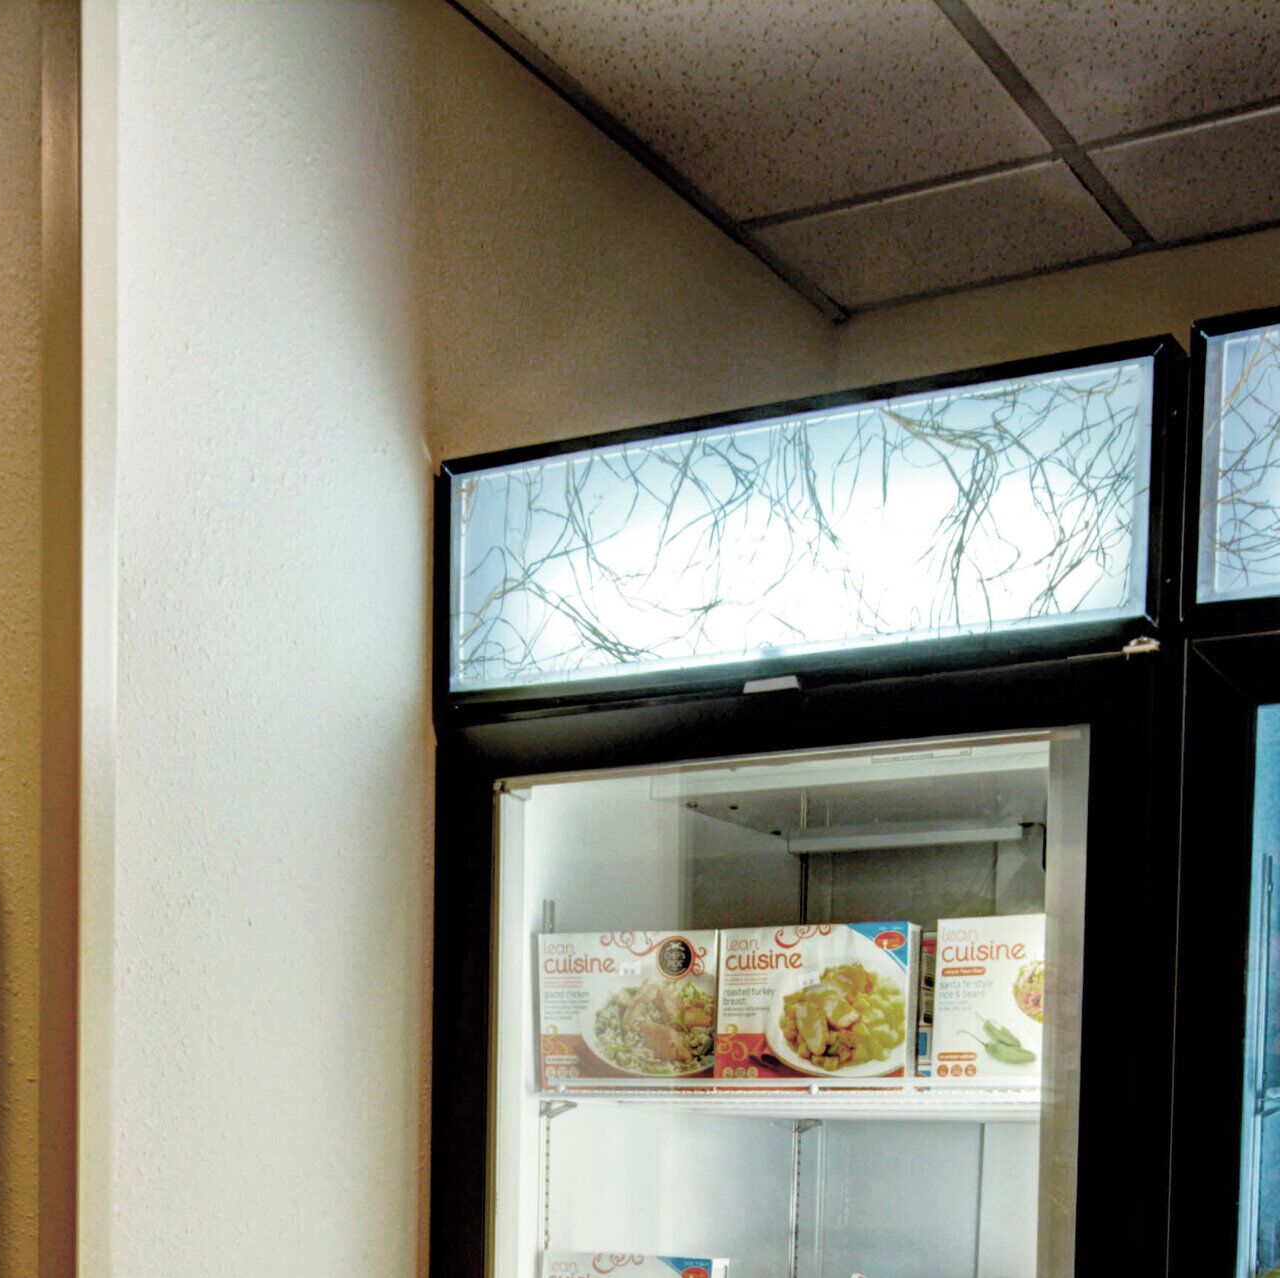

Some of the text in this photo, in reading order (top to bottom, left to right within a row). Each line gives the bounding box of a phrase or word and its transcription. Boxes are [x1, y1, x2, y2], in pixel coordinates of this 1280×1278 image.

[726, 937, 759, 951] lean
[941, 940, 1026, 963] cuisine
[543, 954, 616, 974] cuisine
[725, 949, 803, 971] cuisine
